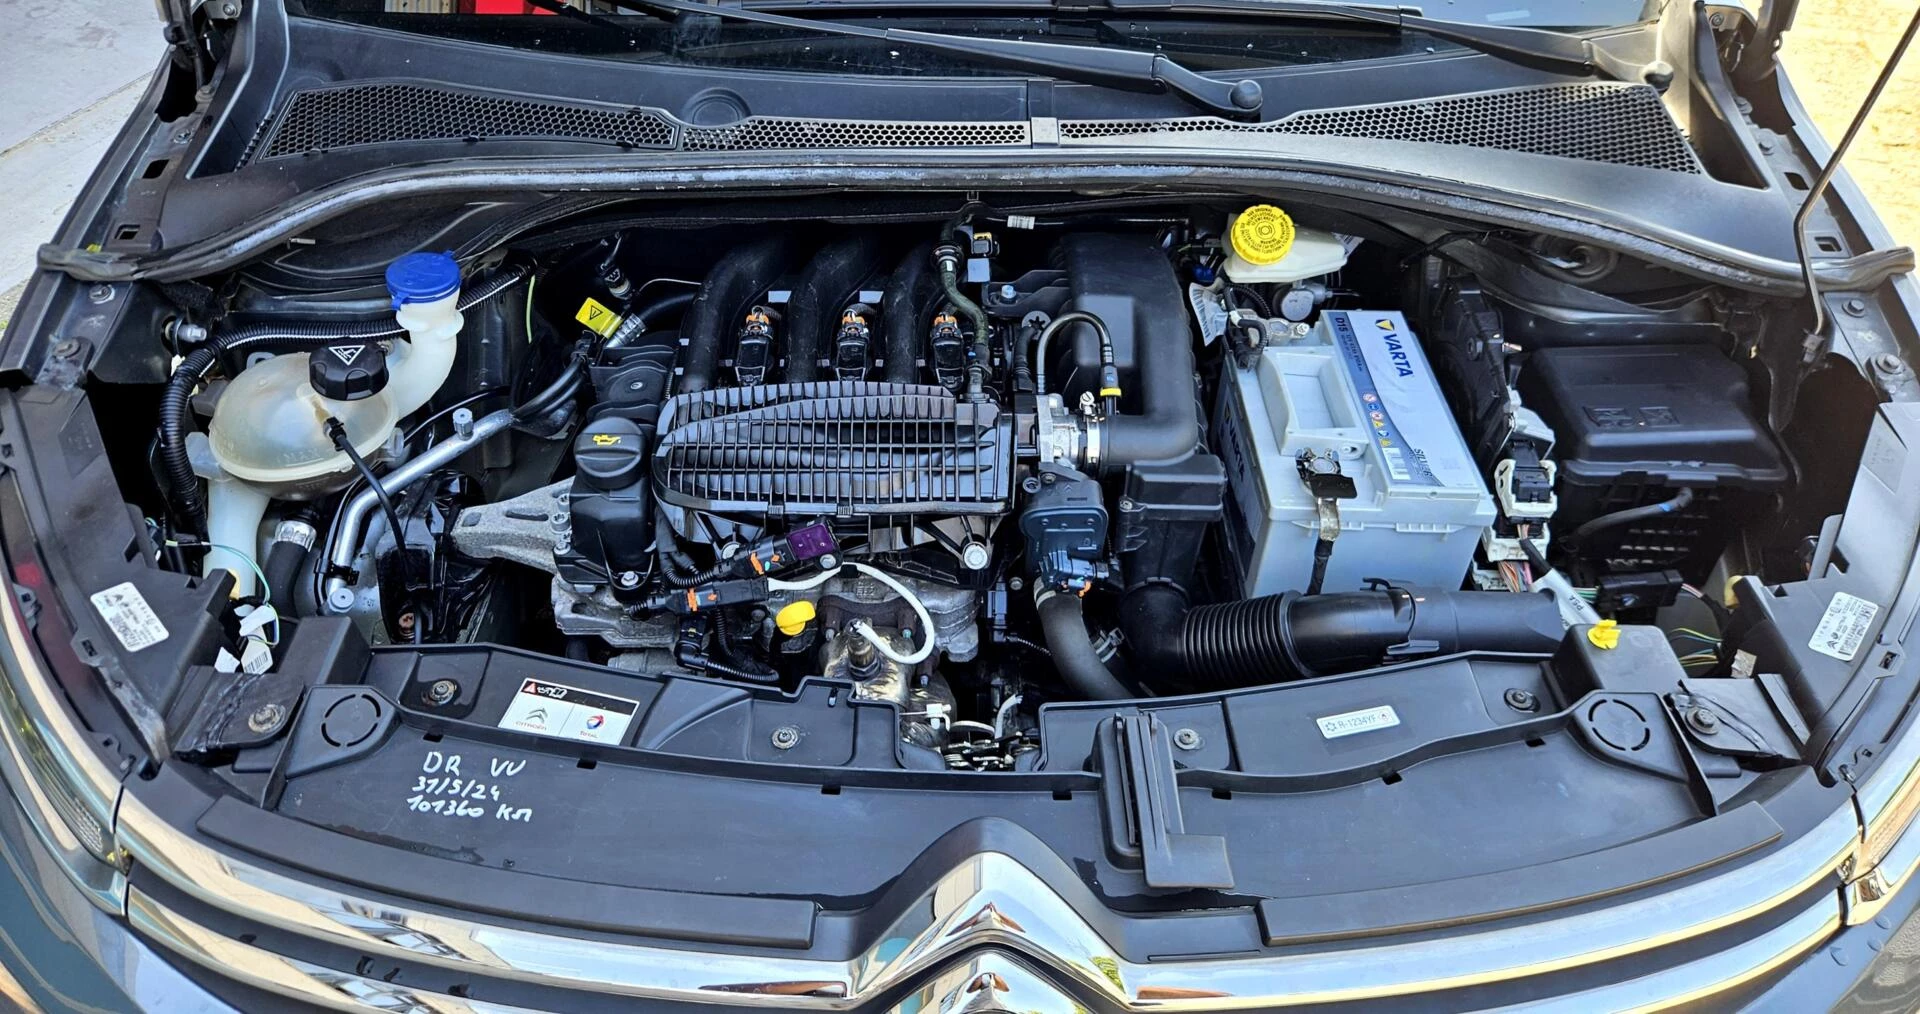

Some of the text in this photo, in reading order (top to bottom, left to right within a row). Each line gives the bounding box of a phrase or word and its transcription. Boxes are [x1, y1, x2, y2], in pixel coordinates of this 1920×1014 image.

[1335, 317, 1348, 332] D15
[1383, 333, 1414, 378] VARTA
[423, 752, 461, 776] DR
[412, 776, 500, 801] 31/5/24
[406, 794, 485, 818] 101360
